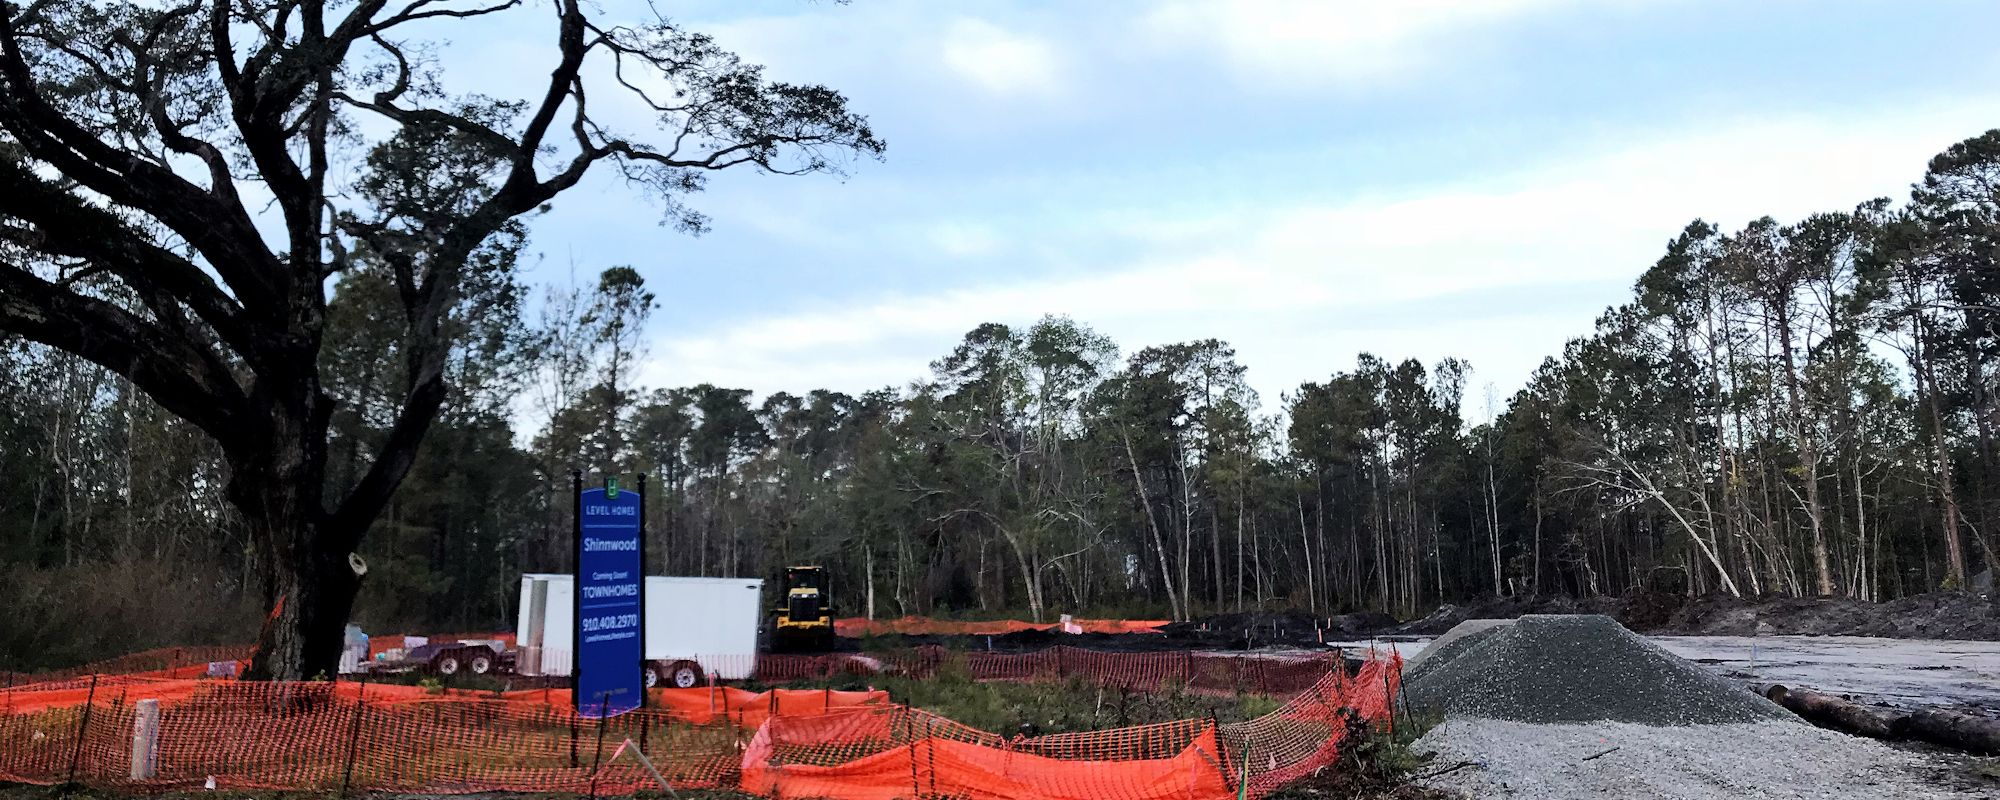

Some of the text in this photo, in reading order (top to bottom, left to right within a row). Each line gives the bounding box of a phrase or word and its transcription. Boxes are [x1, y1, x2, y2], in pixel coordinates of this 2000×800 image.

[586, 505, 635, 516] LEVEL HOMES
[584, 537, 637, 552] Shinnwood
[582, 584, 638, 599] TOWNHOMES
[582, 614, 638, 632] 910.408.2970
